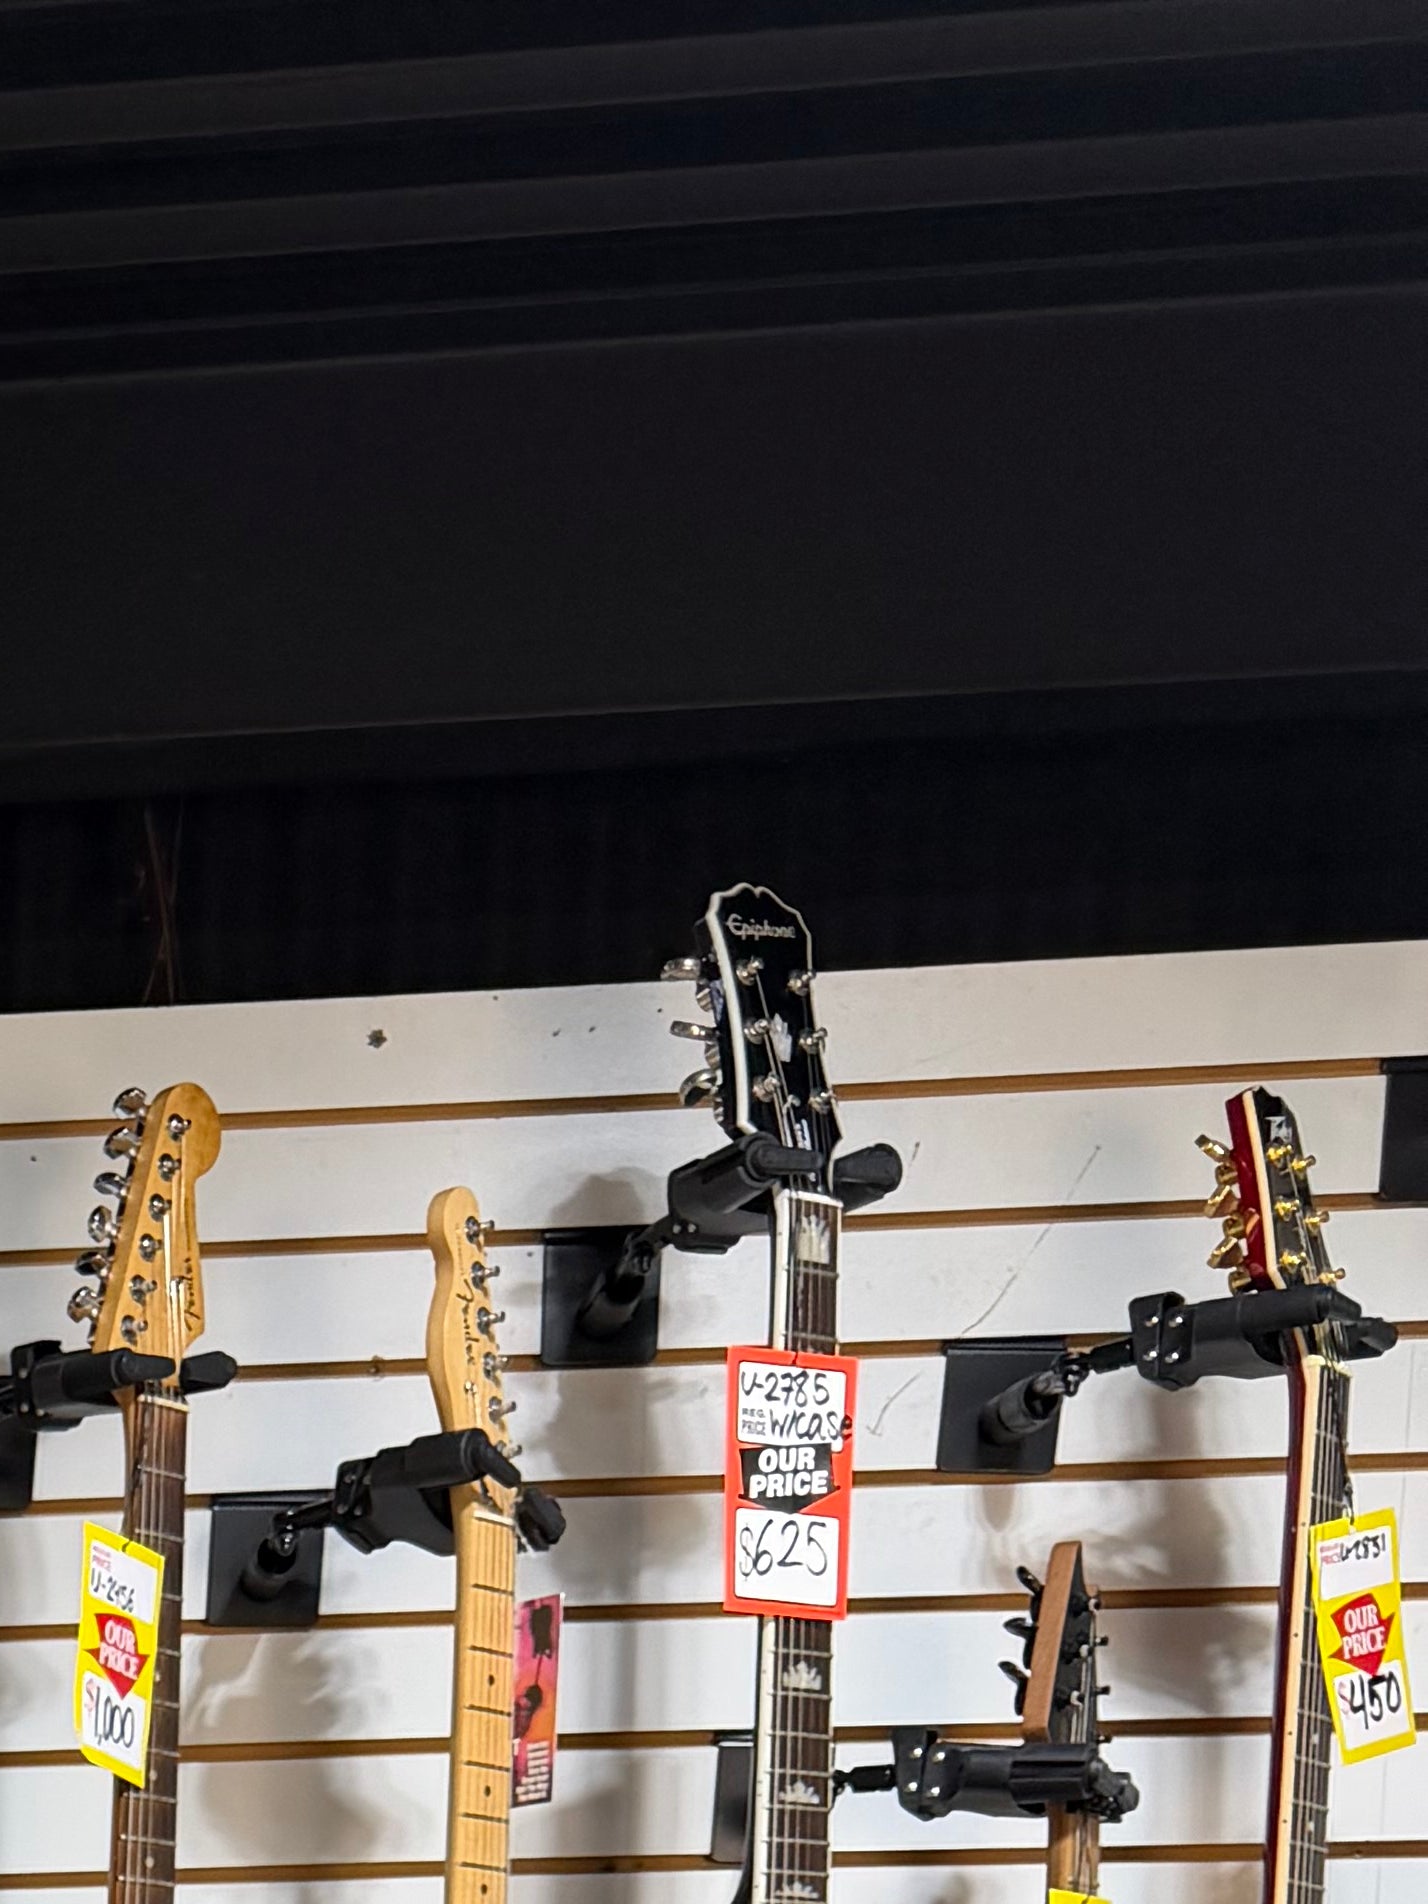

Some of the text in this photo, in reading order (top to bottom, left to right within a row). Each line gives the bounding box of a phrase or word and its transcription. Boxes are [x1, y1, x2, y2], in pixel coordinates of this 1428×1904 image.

[725, 913, 797, 941] Epiphone
[758, 1446, 817, 1473] OUR
[748, 1470, 829, 1500] PRICE
[739, 1518, 829, 1582] $625
[1343, 1604, 1379, 1633] OUR
[104, 1619, 136, 1655] OUR
[1342, 1626, 1387, 1661] PRICE
[98, 1641, 141, 1682] PRICE
[1337, 1670, 1402, 1731] $450
